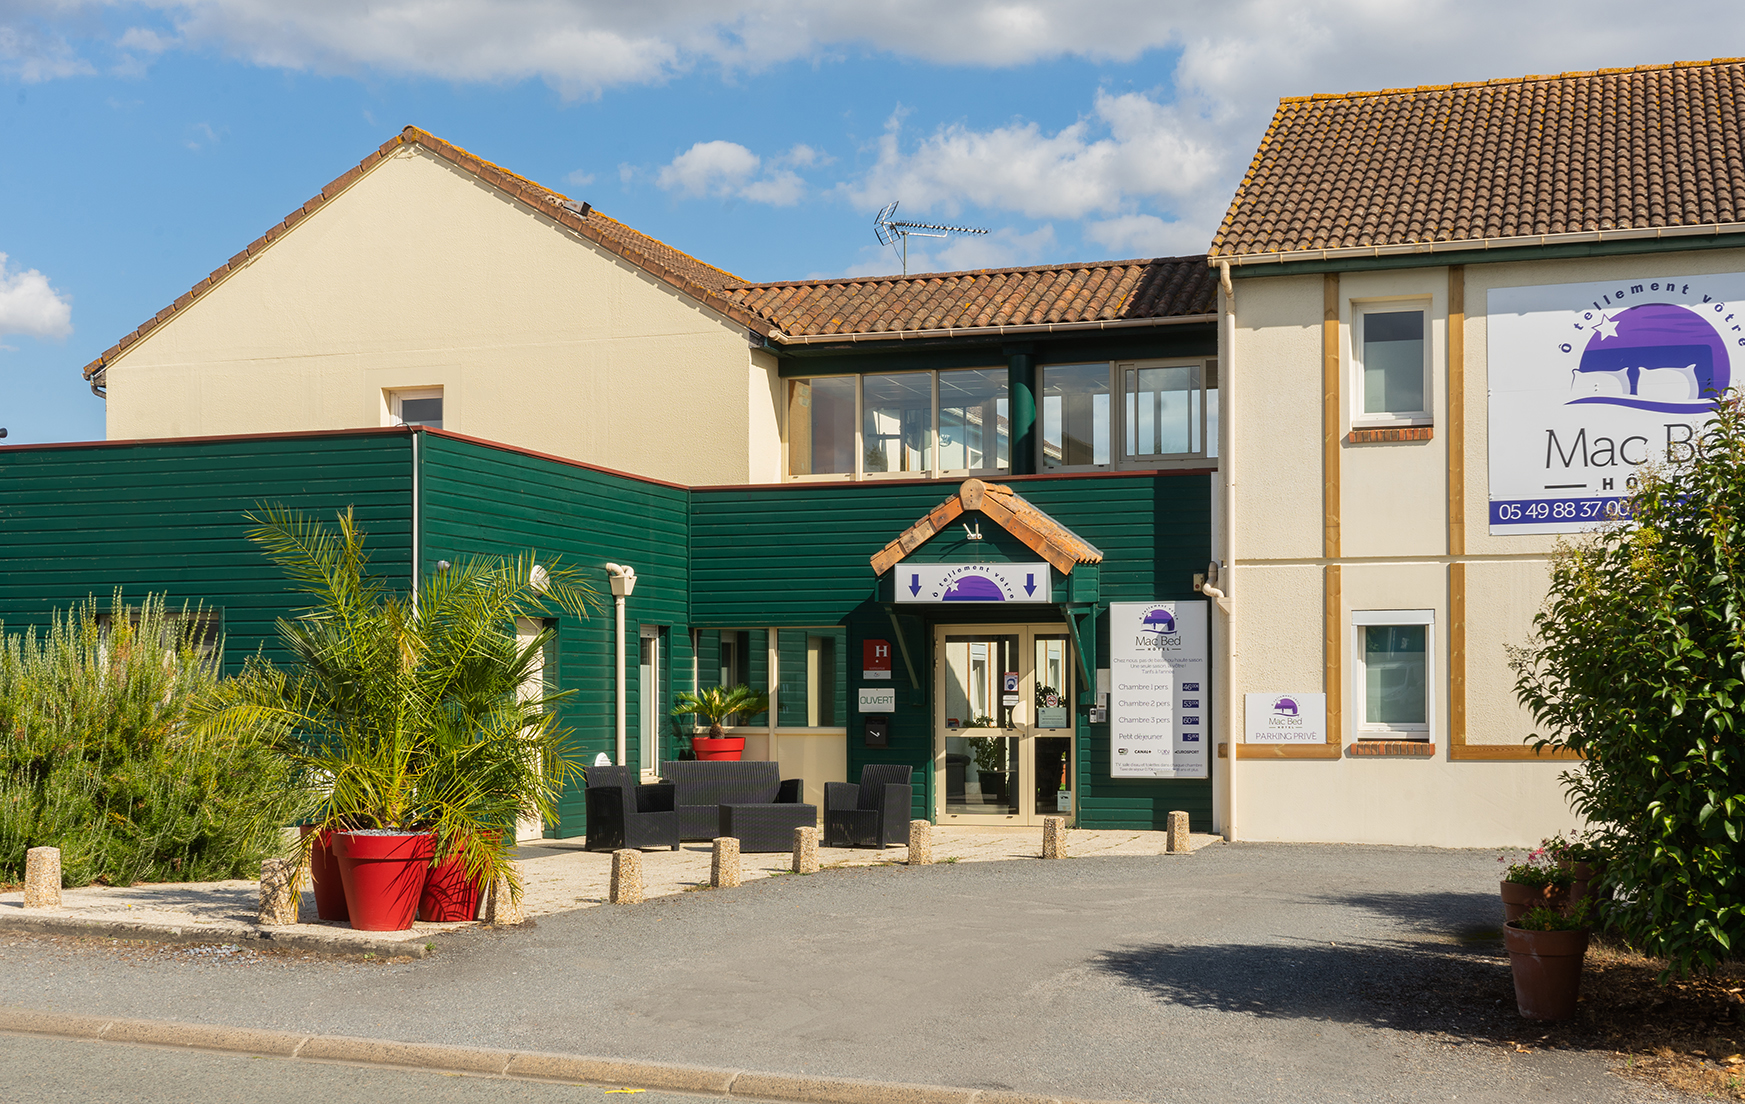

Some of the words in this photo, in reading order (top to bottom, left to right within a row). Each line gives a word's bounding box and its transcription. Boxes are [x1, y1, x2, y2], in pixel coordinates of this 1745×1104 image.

[1574, 282, 1690, 331] tellement
[1702, 294, 1745, 346] vôtre
[1546, 428, 1648, 469] Mac
[1499, 502, 1522, 520] 05
[1525, 502, 1549, 520] 49
[1552, 501, 1576, 518] 88
[1580, 500, 1602, 517] 37
[939, 565, 990, 587] tellement
[995, 572, 1014, 598] vôtre
[1136, 636, 1158, 646] Mac
[1161, 636, 1182, 646] Bed
[875, 645, 888, 657] H
[860, 696, 893, 704] OUVERT
[1134, 732, 1162, 741] déjeuner
